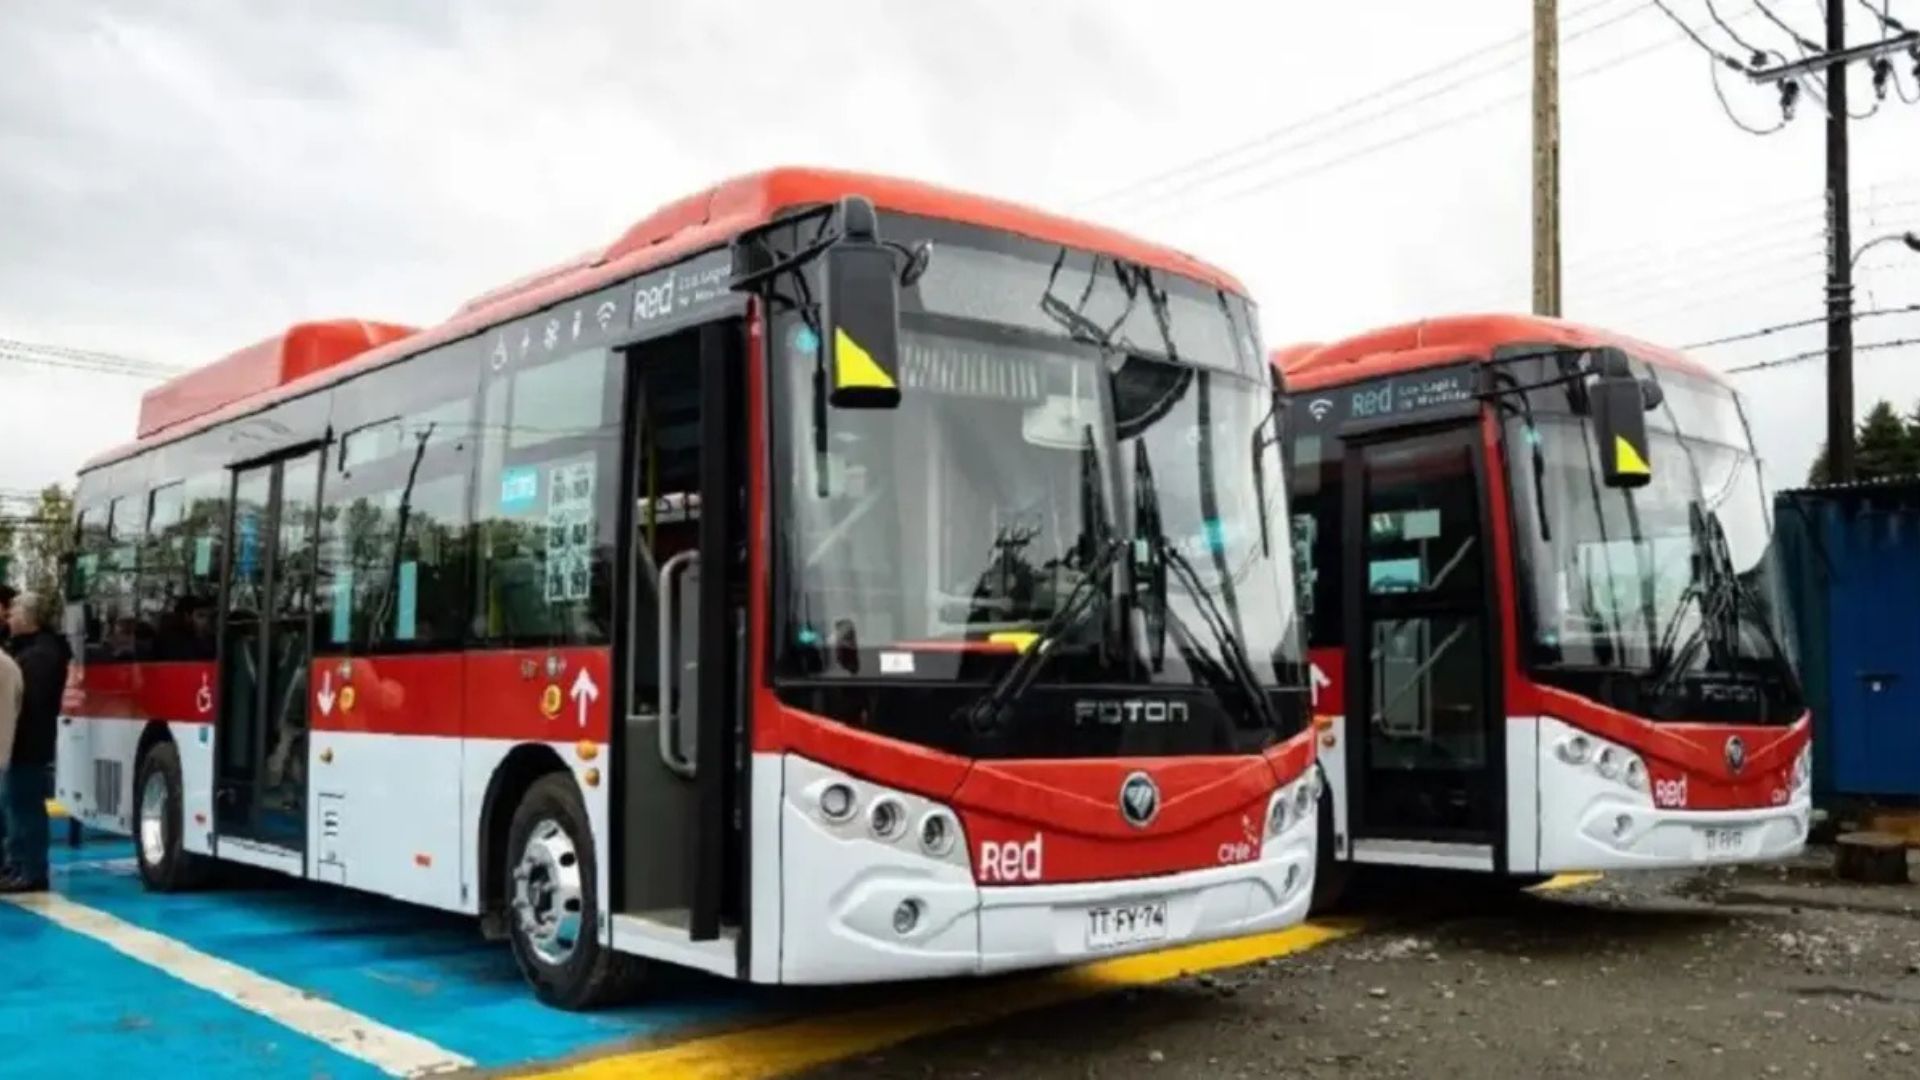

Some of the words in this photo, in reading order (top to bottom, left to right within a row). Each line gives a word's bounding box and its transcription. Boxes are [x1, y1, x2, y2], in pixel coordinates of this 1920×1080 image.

[634, 270, 676, 321] Red
[1352, 378, 1392, 416] Red
[1075, 700, 1188, 724] FOTON
[1655, 773, 1688, 806] Red
[980, 831, 1042, 880] Red
